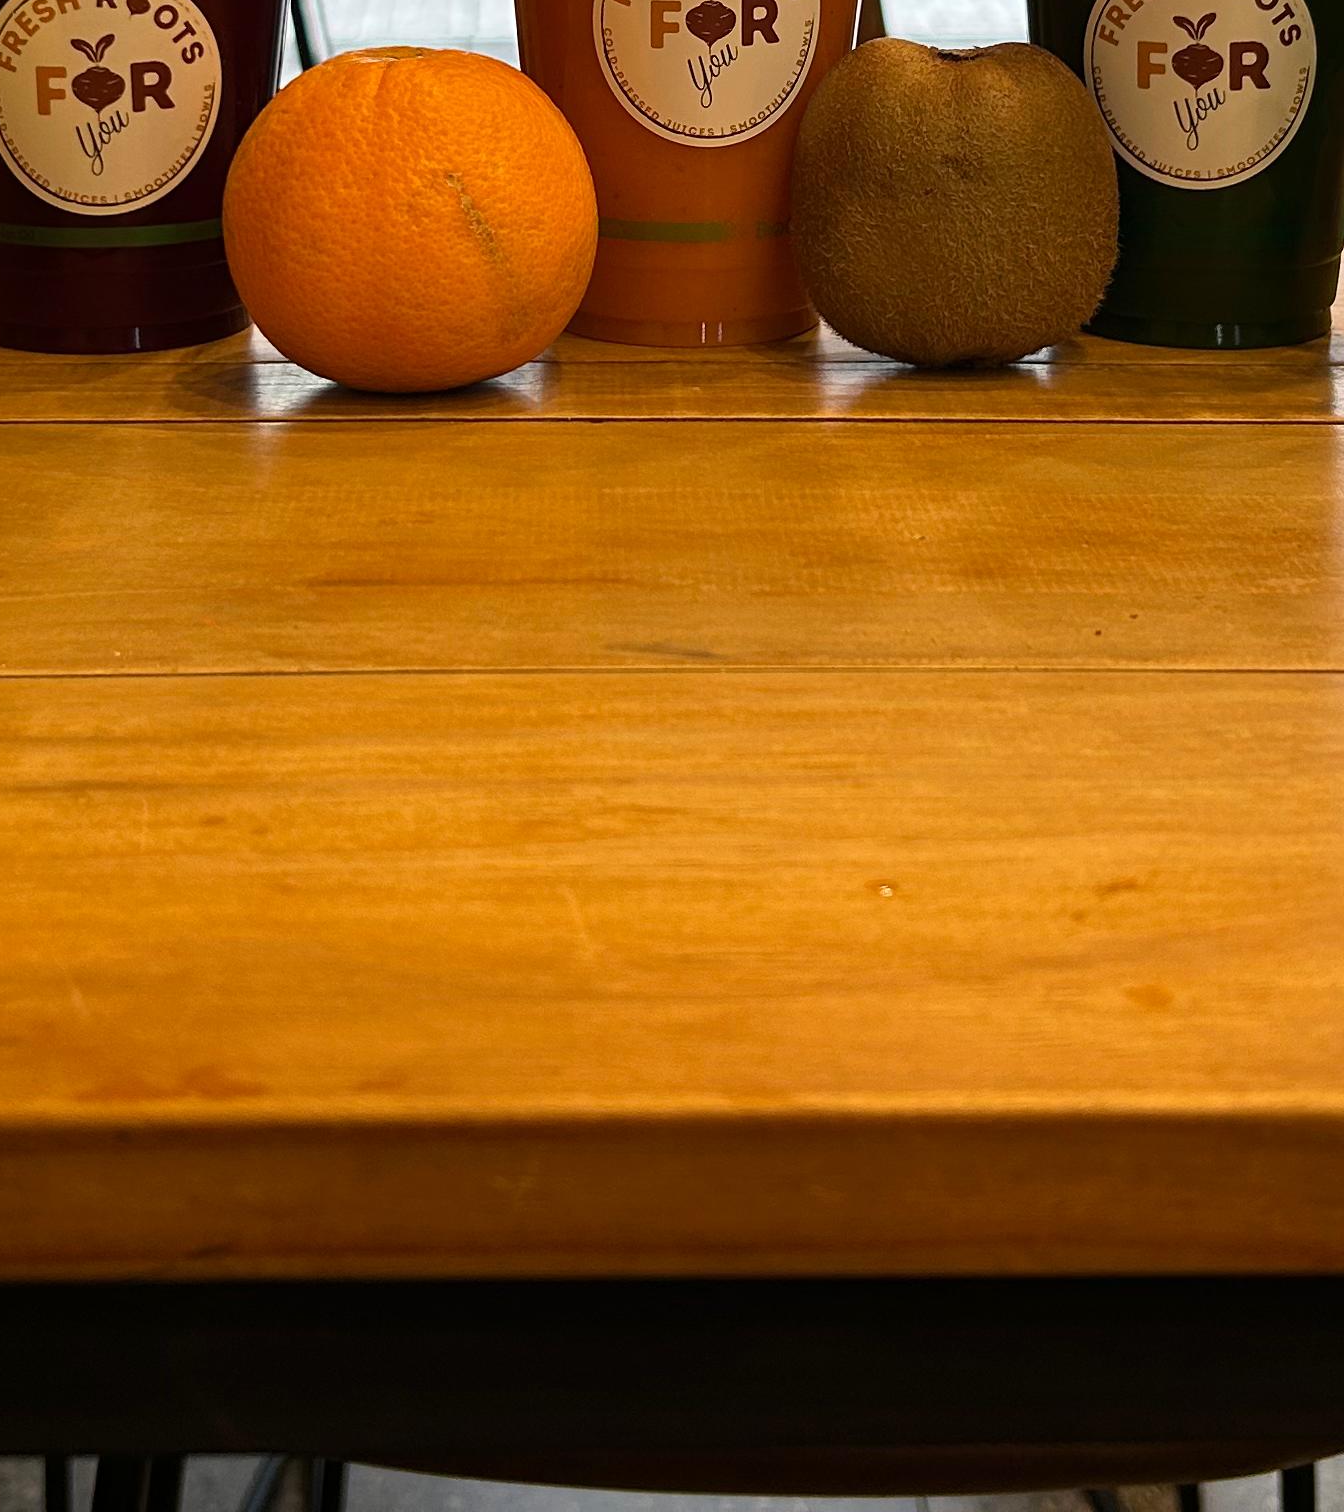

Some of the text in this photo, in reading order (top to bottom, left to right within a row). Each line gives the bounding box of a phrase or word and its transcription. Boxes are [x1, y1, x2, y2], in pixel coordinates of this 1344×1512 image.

[662, 118, 715, 136] JUICES
[729, 79, 794, 135] SMOOTHIES
[797, 19, 813, 67] BOWLS
[687, 44, 739, 108] You
[1173, 87, 1227, 151] You
[76, 110, 130, 176] You
[123, 145, 194, 202] SMOOTHIES
[197, 83, 215, 132] BOWLS
[1217, 126, 1287, 178] SMOOTHIES
[1289, 66, 1309, 117] BOWLS
